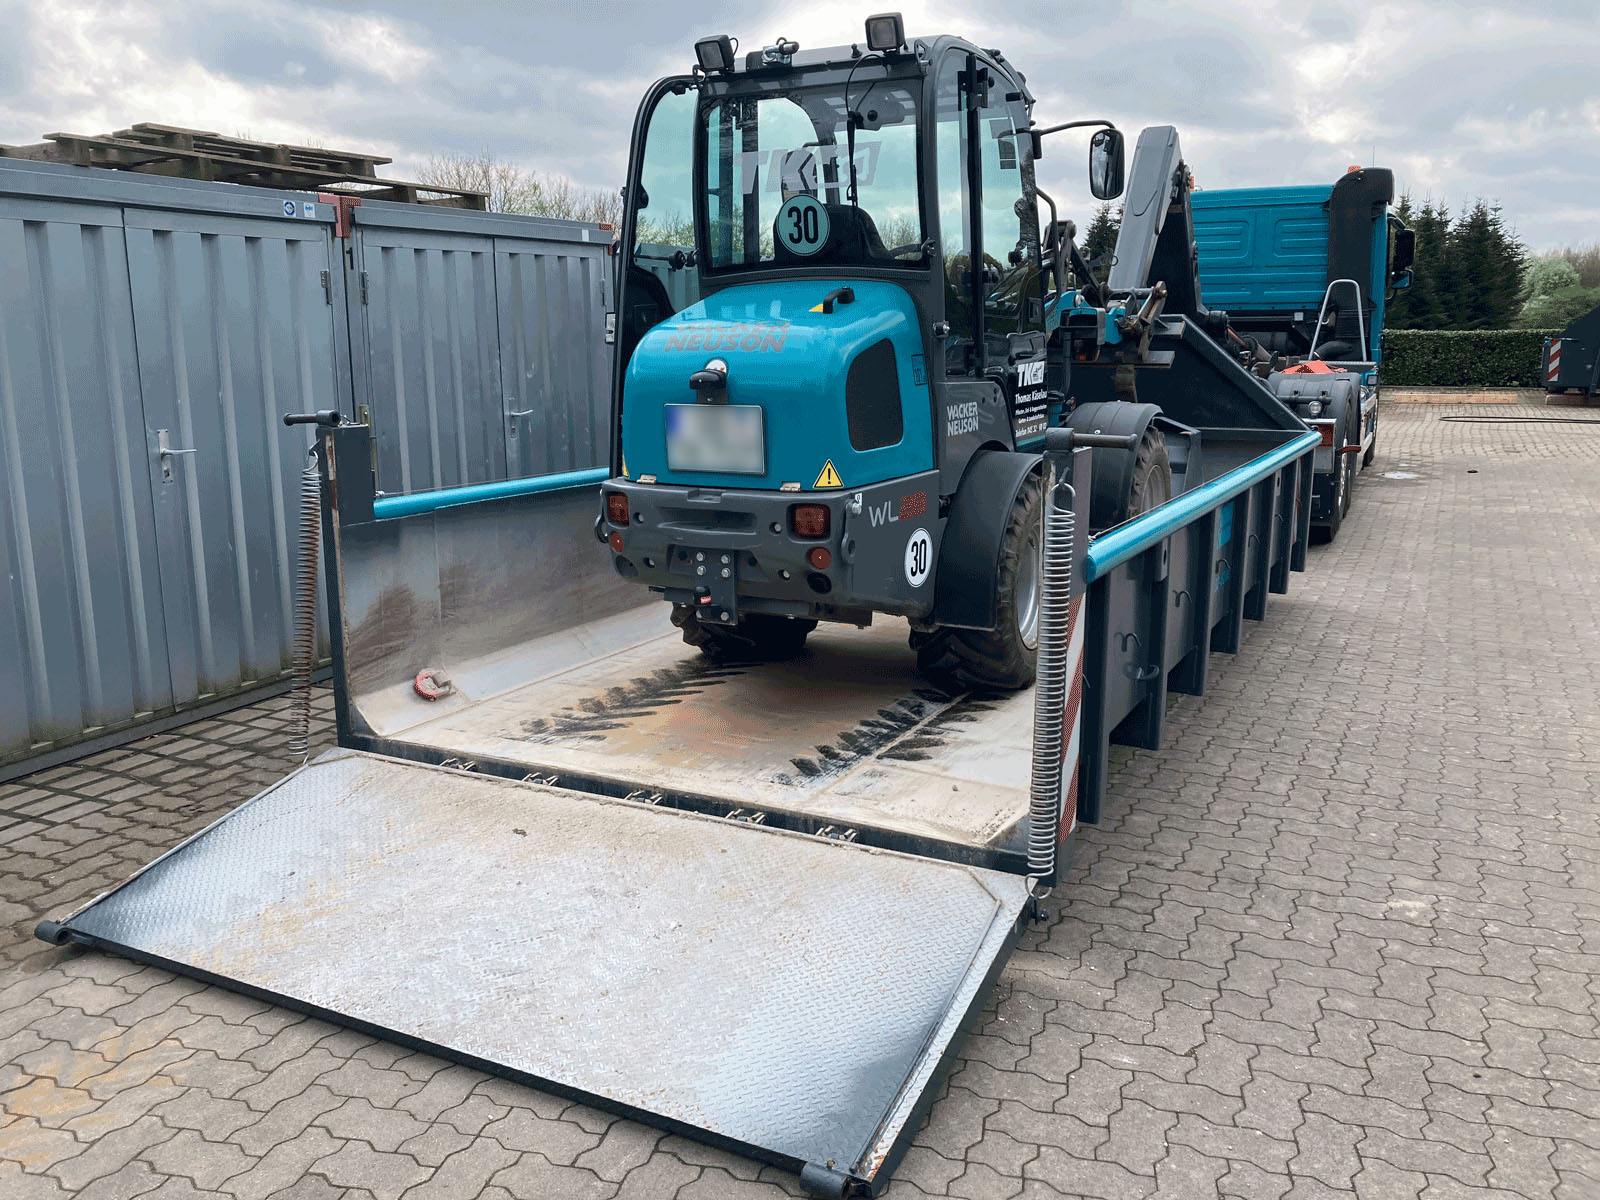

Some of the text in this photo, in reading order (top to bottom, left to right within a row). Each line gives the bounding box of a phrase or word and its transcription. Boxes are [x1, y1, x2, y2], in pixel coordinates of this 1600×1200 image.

[787, 206, 819, 244] 30
[664, 333, 787, 352] NEUSON
[1015, 392, 1031, 404] Thomas
[946, 401, 978, 420] WACKER
[947, 416, 979, 437] NEUSON
[910, 538, 927, 576] 30
